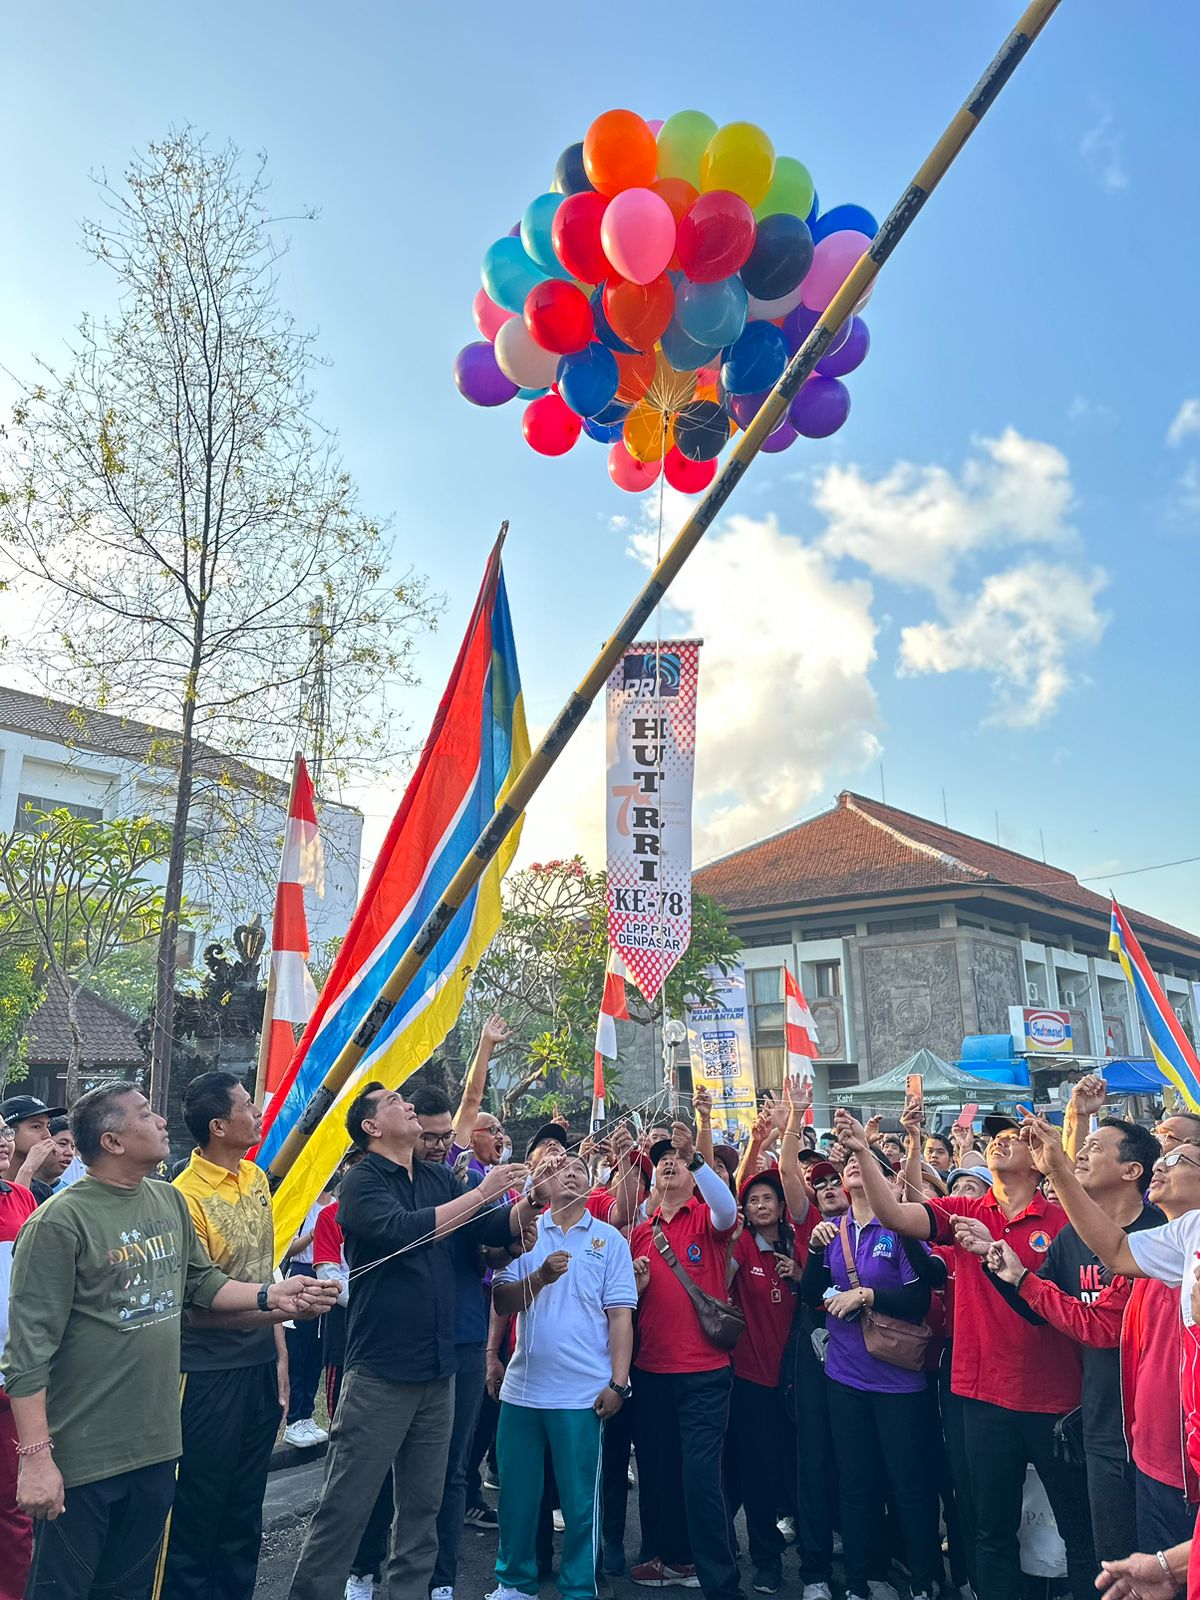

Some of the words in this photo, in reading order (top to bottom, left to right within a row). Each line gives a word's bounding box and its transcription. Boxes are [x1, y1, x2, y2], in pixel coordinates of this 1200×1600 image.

[624, 678, 662, 698] RRI
[614, 887, 683, 916] KE-78
[626, 923, 648, 935] LPP
[619, 933, 681, 950] DENPASAR
[691, 1014, 713, 1022] KAMI
[714, 1012, 744, 1021] ANTAR!
[1033, 1021, 1063, 1038] Indomaret
